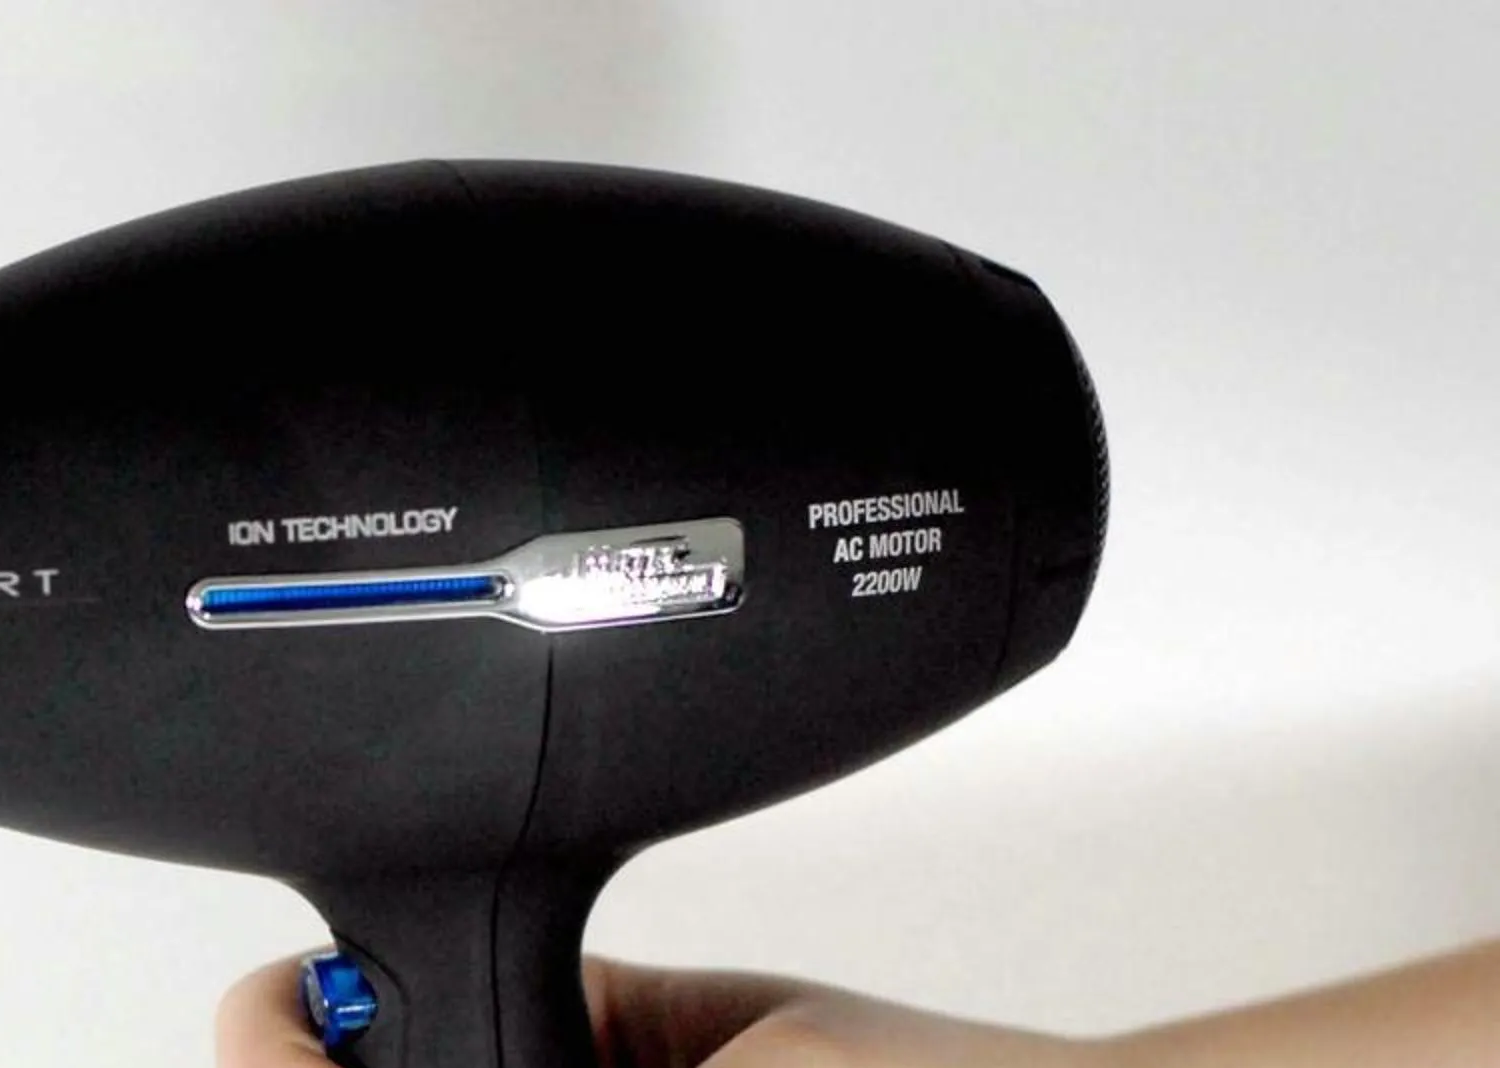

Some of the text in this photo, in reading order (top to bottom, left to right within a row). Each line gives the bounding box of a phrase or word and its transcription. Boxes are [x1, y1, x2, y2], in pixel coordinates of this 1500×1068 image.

[228, 506, 458, 546] ION TECHNOLOGY
[808, 489, 965, 530] PROFESSIONAL
[833, 527, 942, 564] AC MOTOR
[851, 565, 923, 598] 2200W
